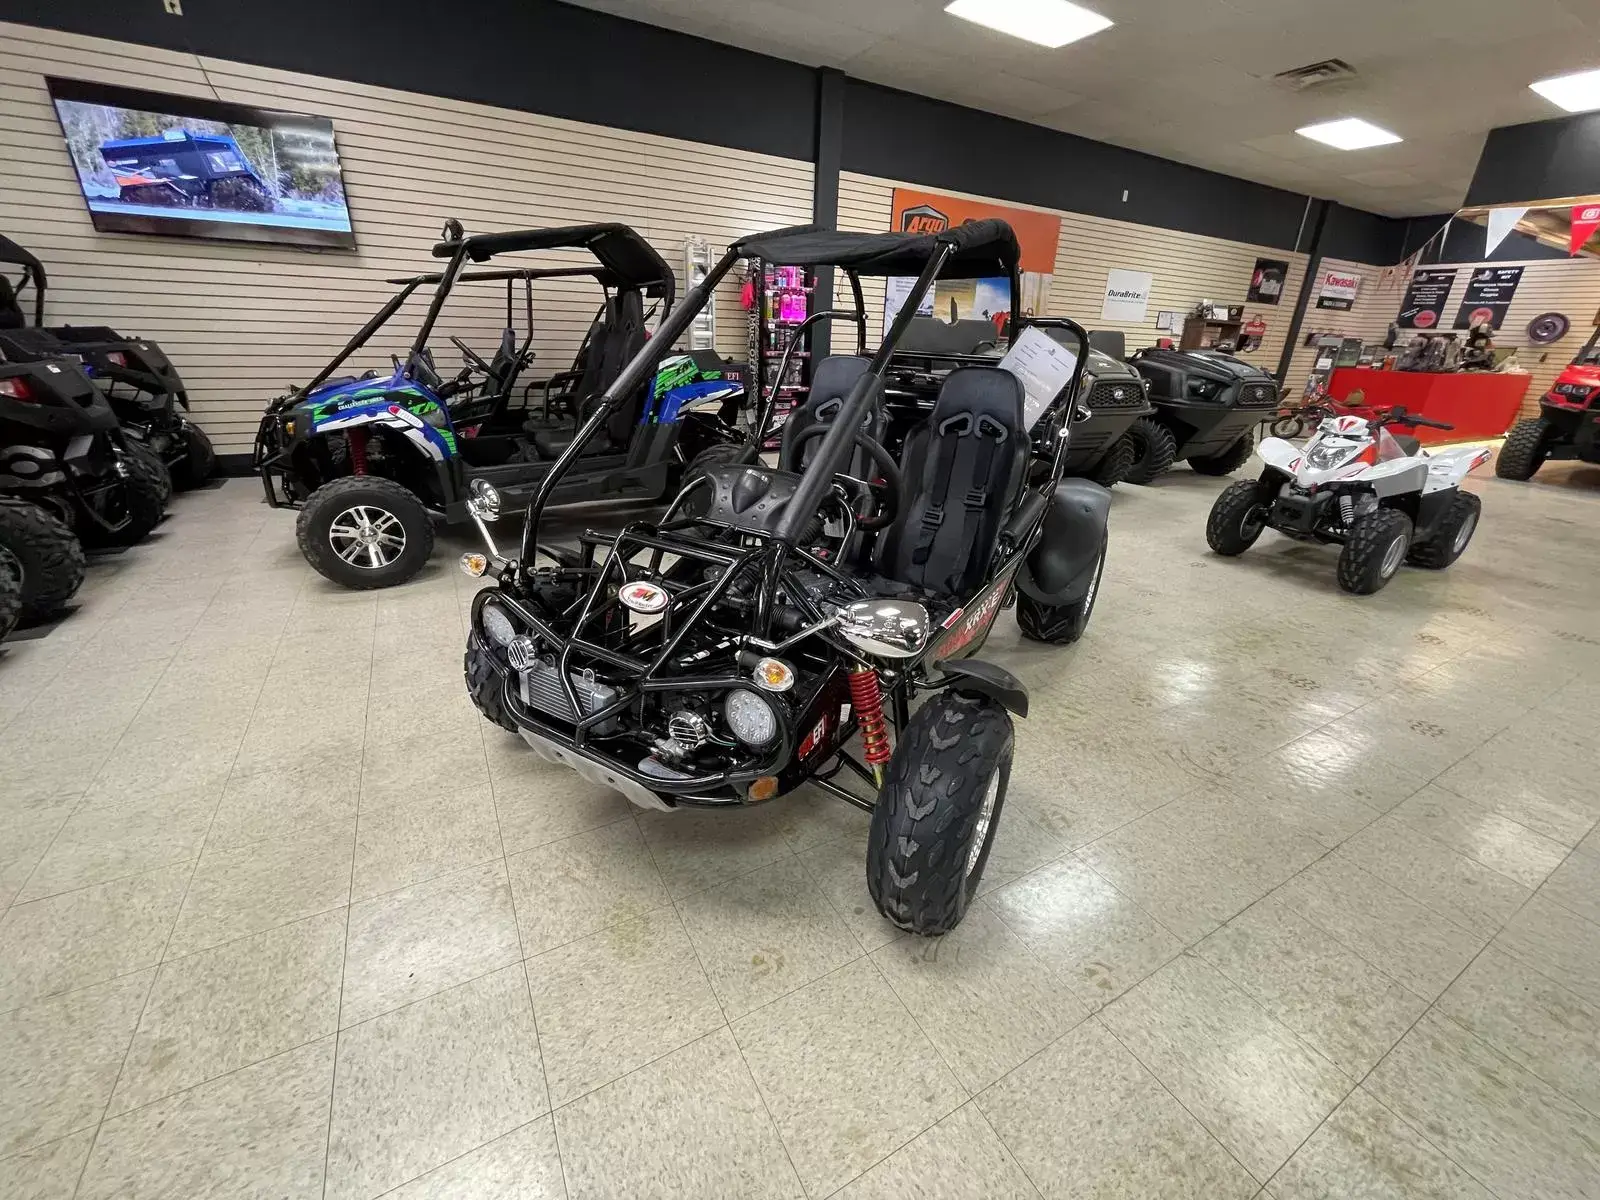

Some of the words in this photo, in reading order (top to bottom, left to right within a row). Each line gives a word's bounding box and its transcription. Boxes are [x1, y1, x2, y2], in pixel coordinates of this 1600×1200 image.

[1326, 273, 1358, 288] Kawasaki
[1108, 289, 1141, 299] DuraBrite
[727, 372, 739, 380] EFI
[813, 717, 825, 745] EFI
